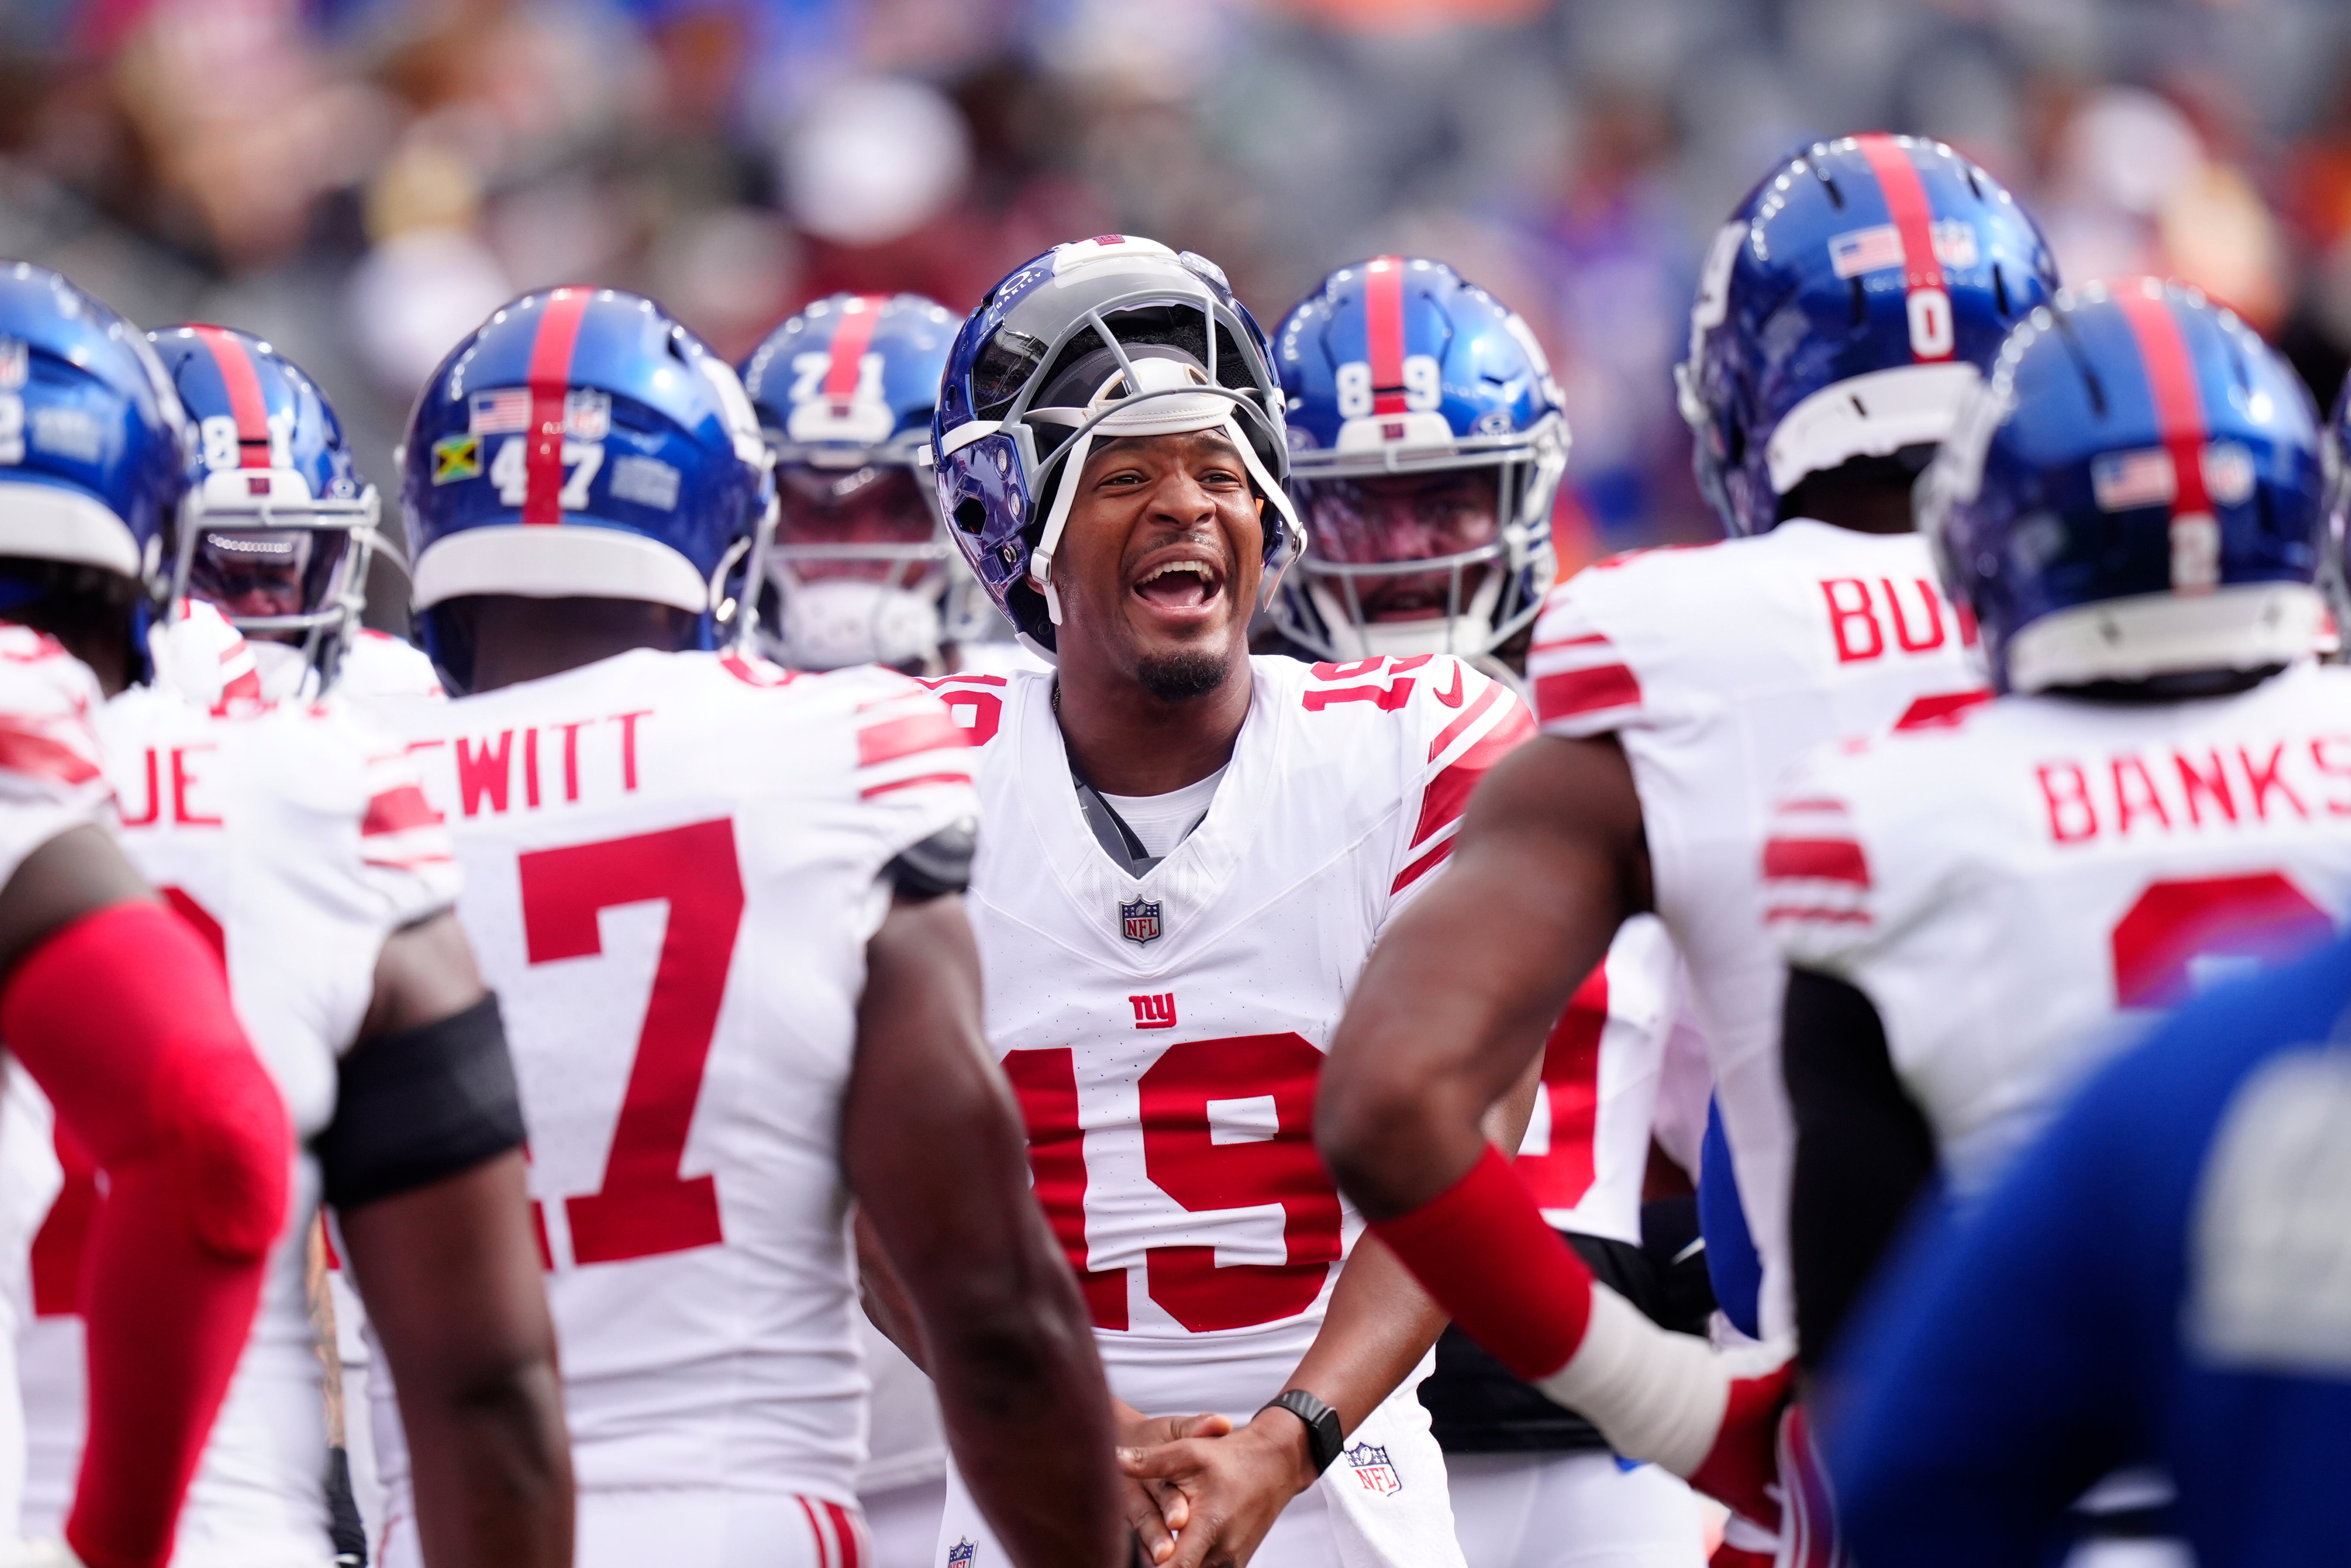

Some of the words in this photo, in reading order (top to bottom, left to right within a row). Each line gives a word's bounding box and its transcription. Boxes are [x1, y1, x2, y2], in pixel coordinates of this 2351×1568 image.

[996, 271, 1041, 309] OAKLEY
[1336, 355, 1442, 420] 89
[201, 415, 294, 470] 81
[490, 437, 605, 510] 47
[1820, 579, 1978, 662] BU
[2036, 737, 2351, 844] BANKS
[1126, 918, 1157, 939] NFL
[1129, 992, 1177, 1029] ny
[518, 816, 745, 1271] 7
[999, 1032, 1343, 1333] 19
[1354, 1467, 1397, 1493] NFL
